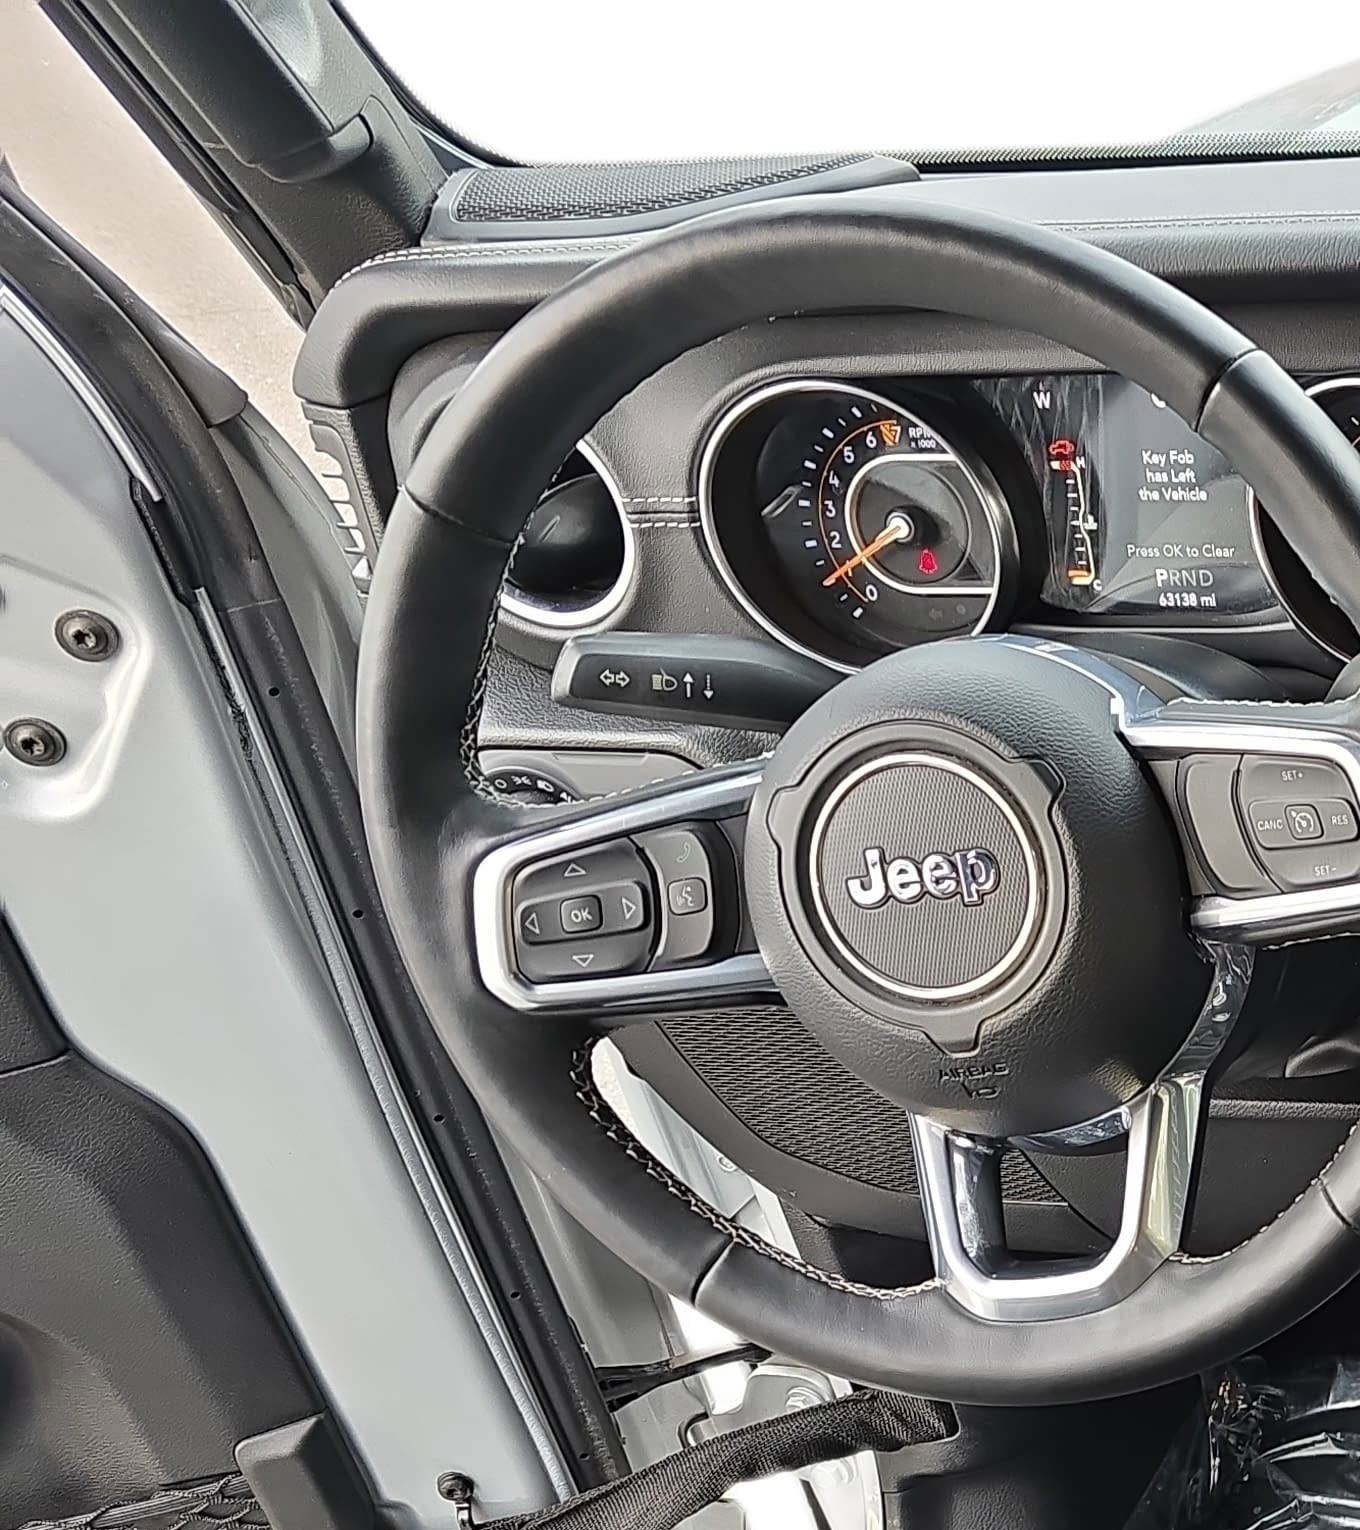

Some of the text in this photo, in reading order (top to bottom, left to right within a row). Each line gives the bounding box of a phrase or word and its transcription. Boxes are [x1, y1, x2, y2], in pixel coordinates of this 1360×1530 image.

[1033, 391, 1051, 409] W
[865, 431, 877, 449] 6
[917, 439, 936, 449] 1000
[843, 446, 855, 464] 5
[1141, 449, 1194, 467] Key Fob
[829, 469, 841, 488] 4
[1146, 468, 1197, 483] has Left
[1138, 486, 1208, 501] the Vehicle
[824, 500, 836, 518] 3
[830, 531, 842, 549] 2
[1127, 544, 1235, 558] Press OK to Clear
[865, 584, 878, 602] 0
[1159, 592, 1216, 607] 63138 mi
[1257, 819, 1283, 831] CANC
[1331, 815, 1348, 825] RES
[846, 847, 1000, 909] Jeep
[570, 906, 593, 924] OK
